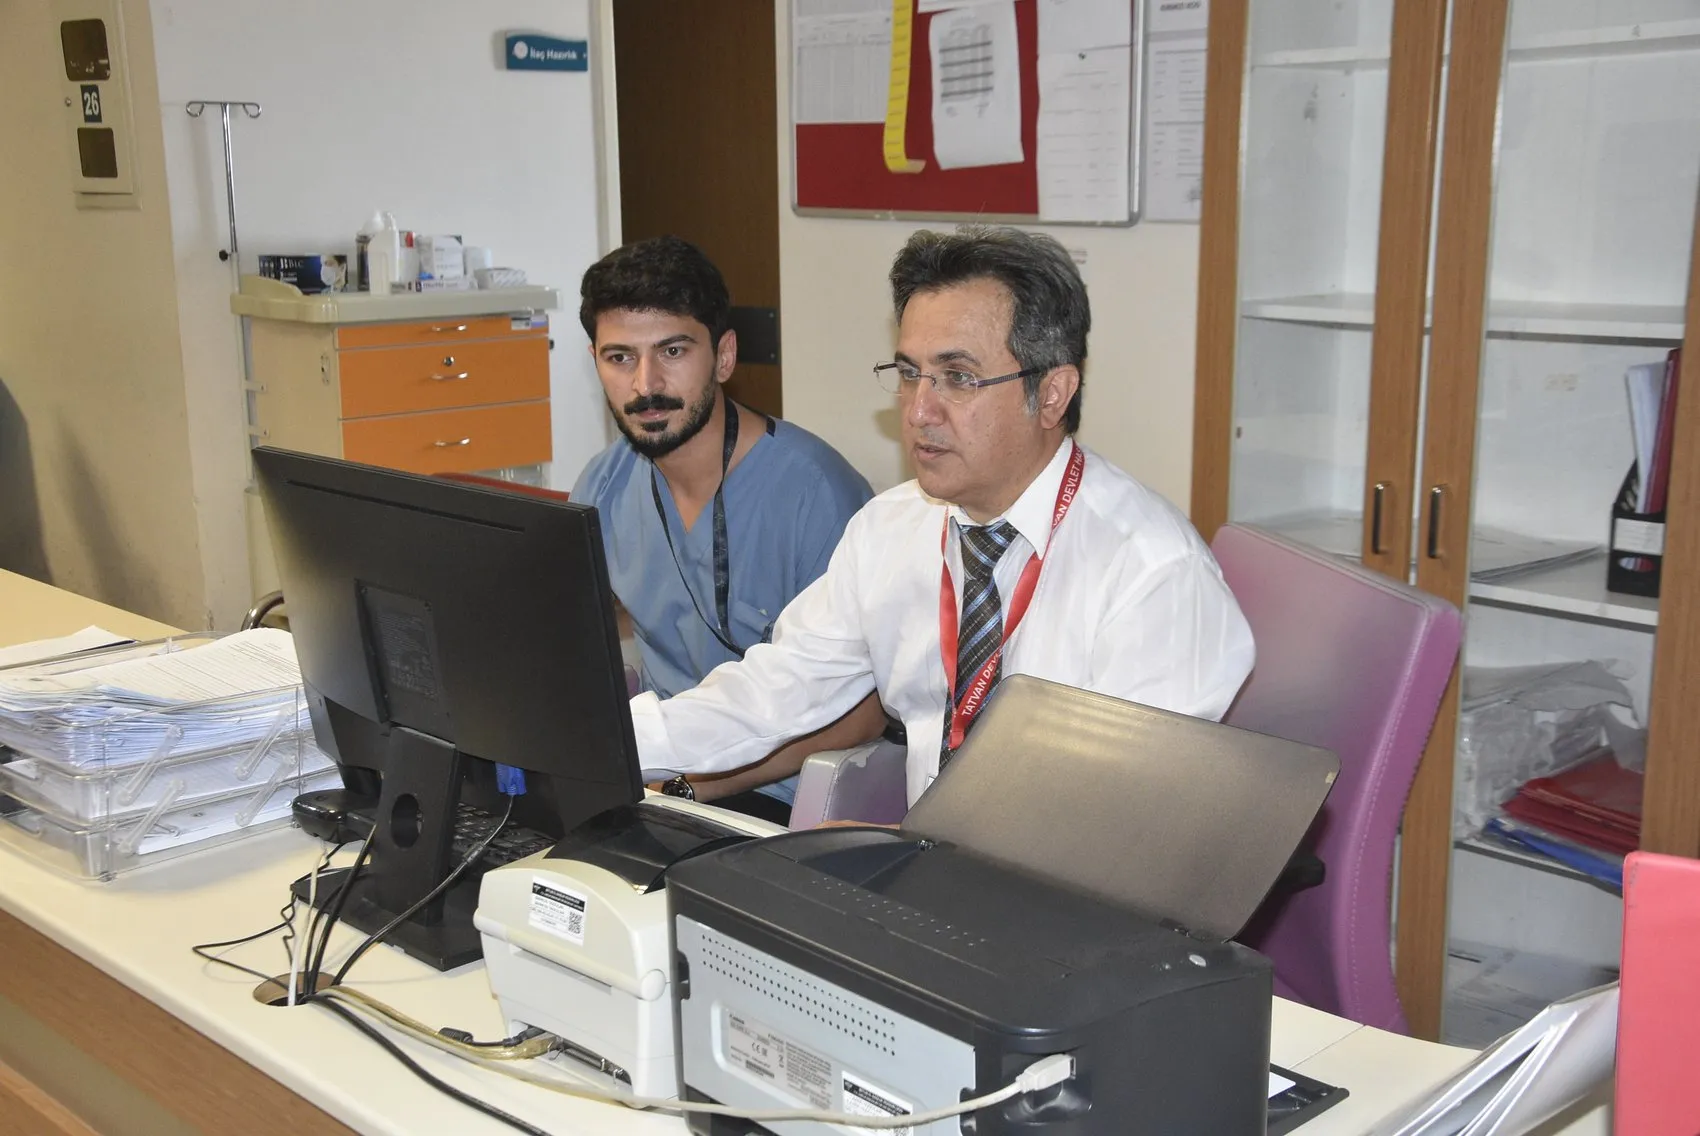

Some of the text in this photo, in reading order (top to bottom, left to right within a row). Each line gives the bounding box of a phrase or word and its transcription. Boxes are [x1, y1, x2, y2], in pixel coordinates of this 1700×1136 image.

[83, 92, 99, 116] 26
[1062, 464, 1081, 504] DEVLET
[962, 679, 987, 717] TATVAN
